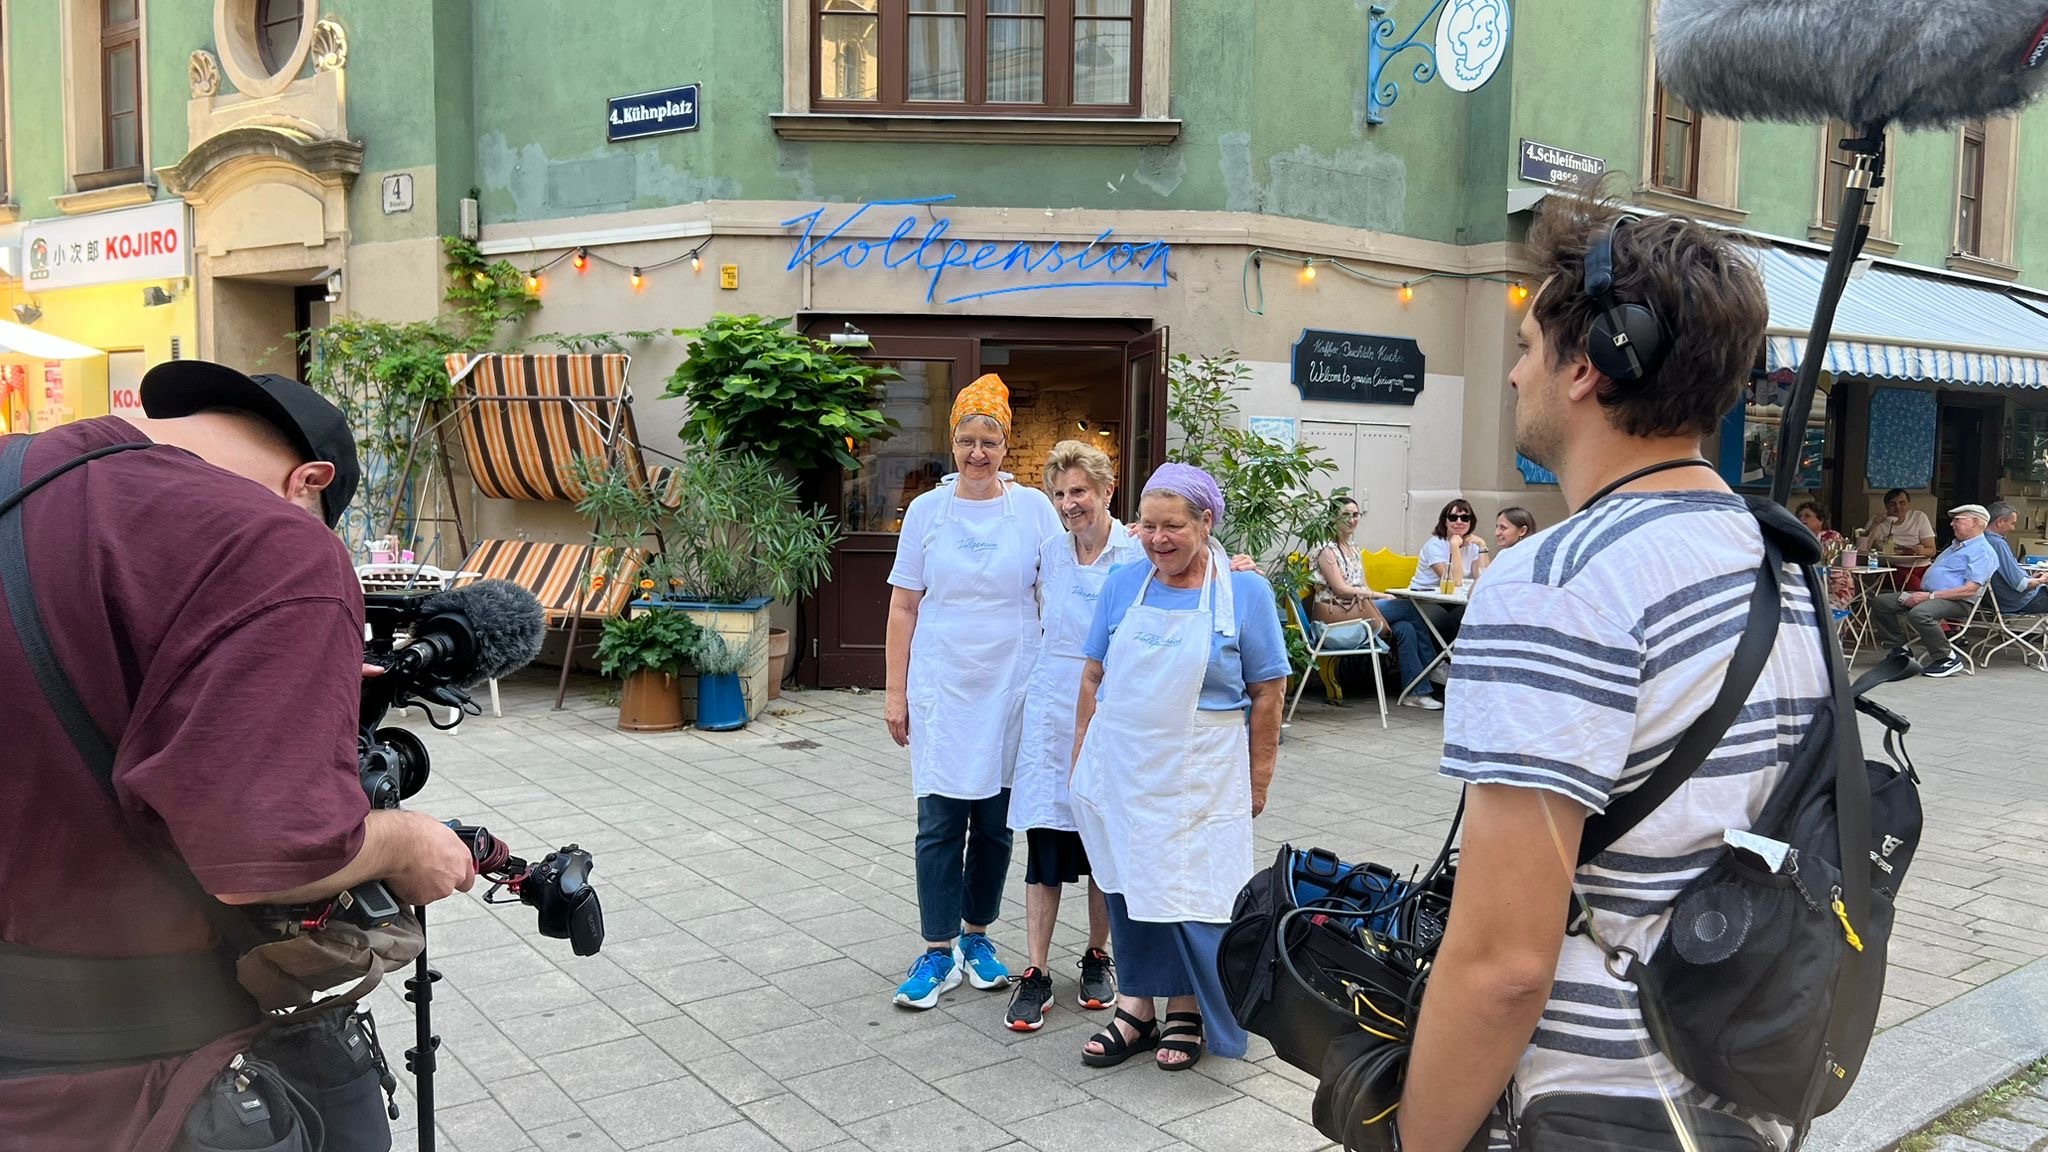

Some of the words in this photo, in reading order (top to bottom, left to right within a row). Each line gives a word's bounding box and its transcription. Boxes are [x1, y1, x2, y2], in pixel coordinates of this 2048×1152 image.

[623, 100, 693, 122] Kühnplatz
[1536, 147, 1603, 175] Schleifmühl-
[392, 178, 401, 200] 4
[106, 228, 178, 261] KOJIRO
[780, 194, 1169, 304] Vollpension
[113, 389, 142, 409] KOJ
